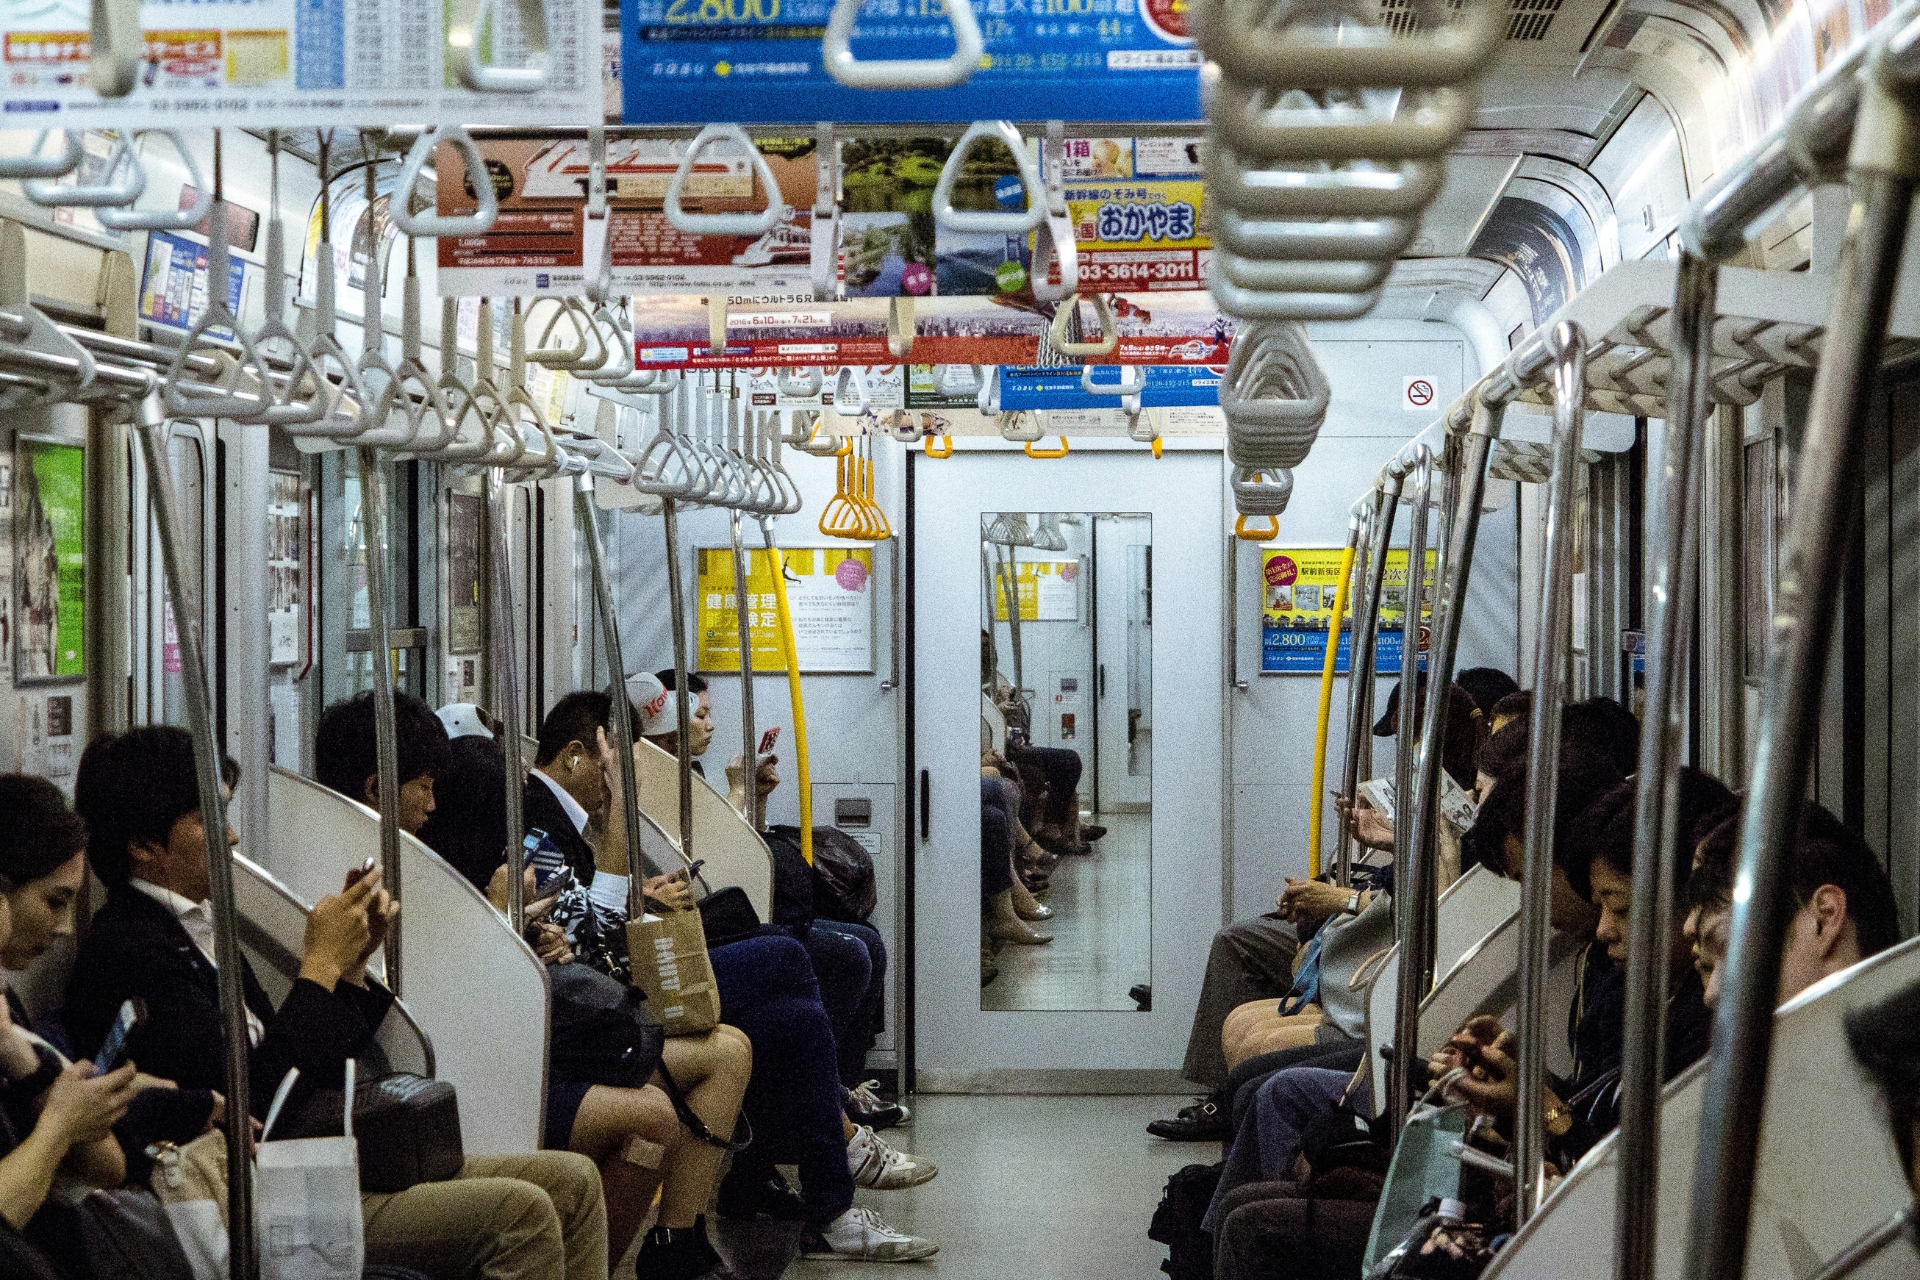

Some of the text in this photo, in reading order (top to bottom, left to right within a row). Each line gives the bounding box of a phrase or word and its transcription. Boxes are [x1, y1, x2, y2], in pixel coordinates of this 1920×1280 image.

[1100, 204, 1192, 240] おかやま
[1081, 263, 1194, 280] 03-3614-3011
